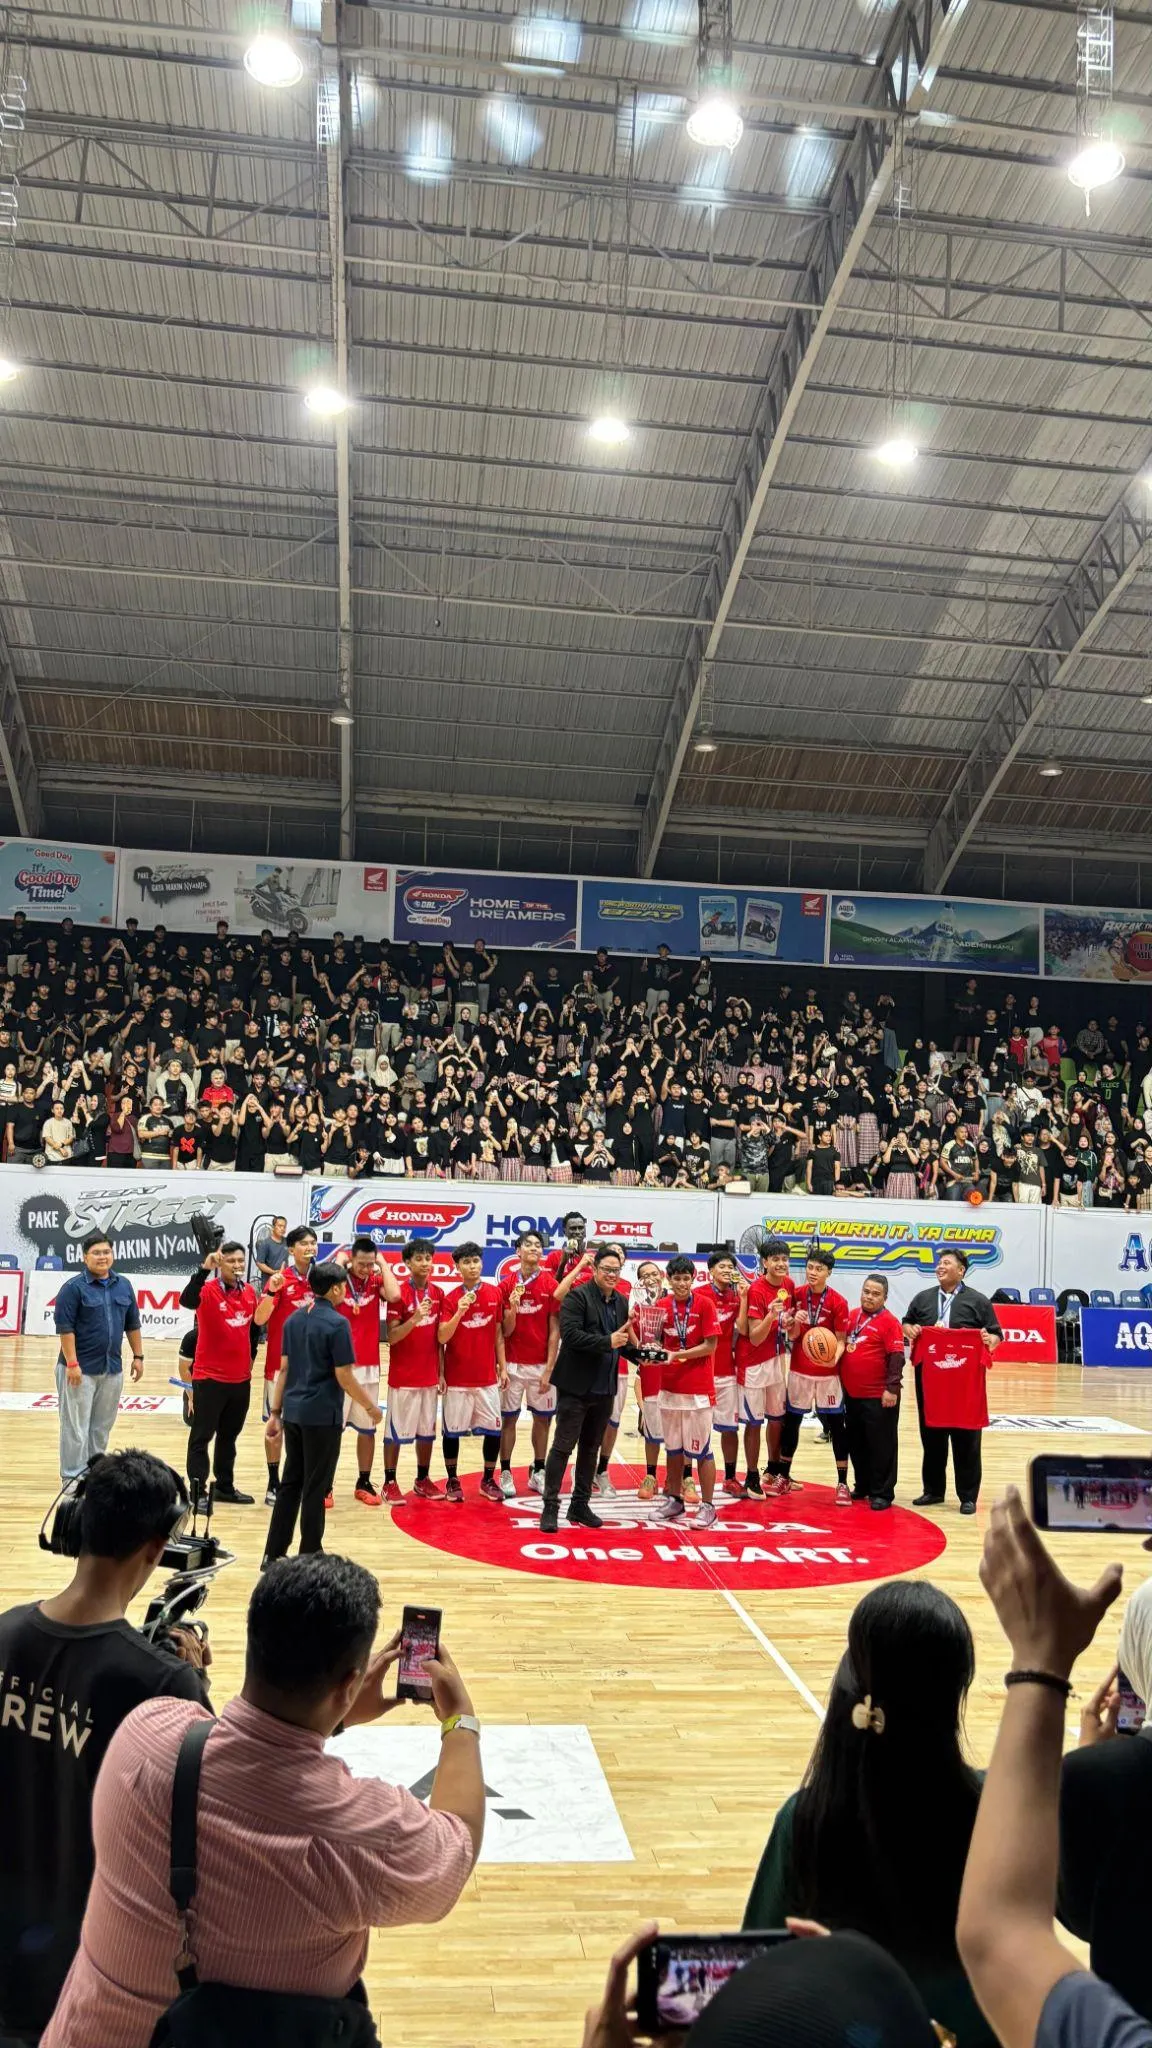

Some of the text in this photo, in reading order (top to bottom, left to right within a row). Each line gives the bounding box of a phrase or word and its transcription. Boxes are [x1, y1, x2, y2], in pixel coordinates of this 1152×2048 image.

[19, 870, 80, 889] Good Day
[30, 886, 67, 899] Time!
[470, 898, 520, 909] HOME
[469, 909, 567, 921] DREAMERS
[1102, 921, 1142, 932] BREAK
[28, 1210, 59, 1229] PAKE
[64, 1194, 238, 1239] STREET
[386, 1211, 446, 1223] HONDA
[486, 1214, 565, 1236] HOM
[599, 1223, 648, 1235] OF THE
[764, 1218, 817, 1234] YANG
[819, 1219, 888, 1238] WORTH
[917, 1224, 942, 1240] YA
[943, 1226, 997, 1243] CUMA
[389, 1263, 462, 1278] ODA
[141, 1310, 180, 1325] Motor
[1115, 1321, 1152, 1350] AQ
[691, 1439, 700, 1451] 13
[519, 1543, 872, 1565] One HEART.
[0, 1670, 94, 1724] FICIAL
[1, 1692, 93, 1760] REW
